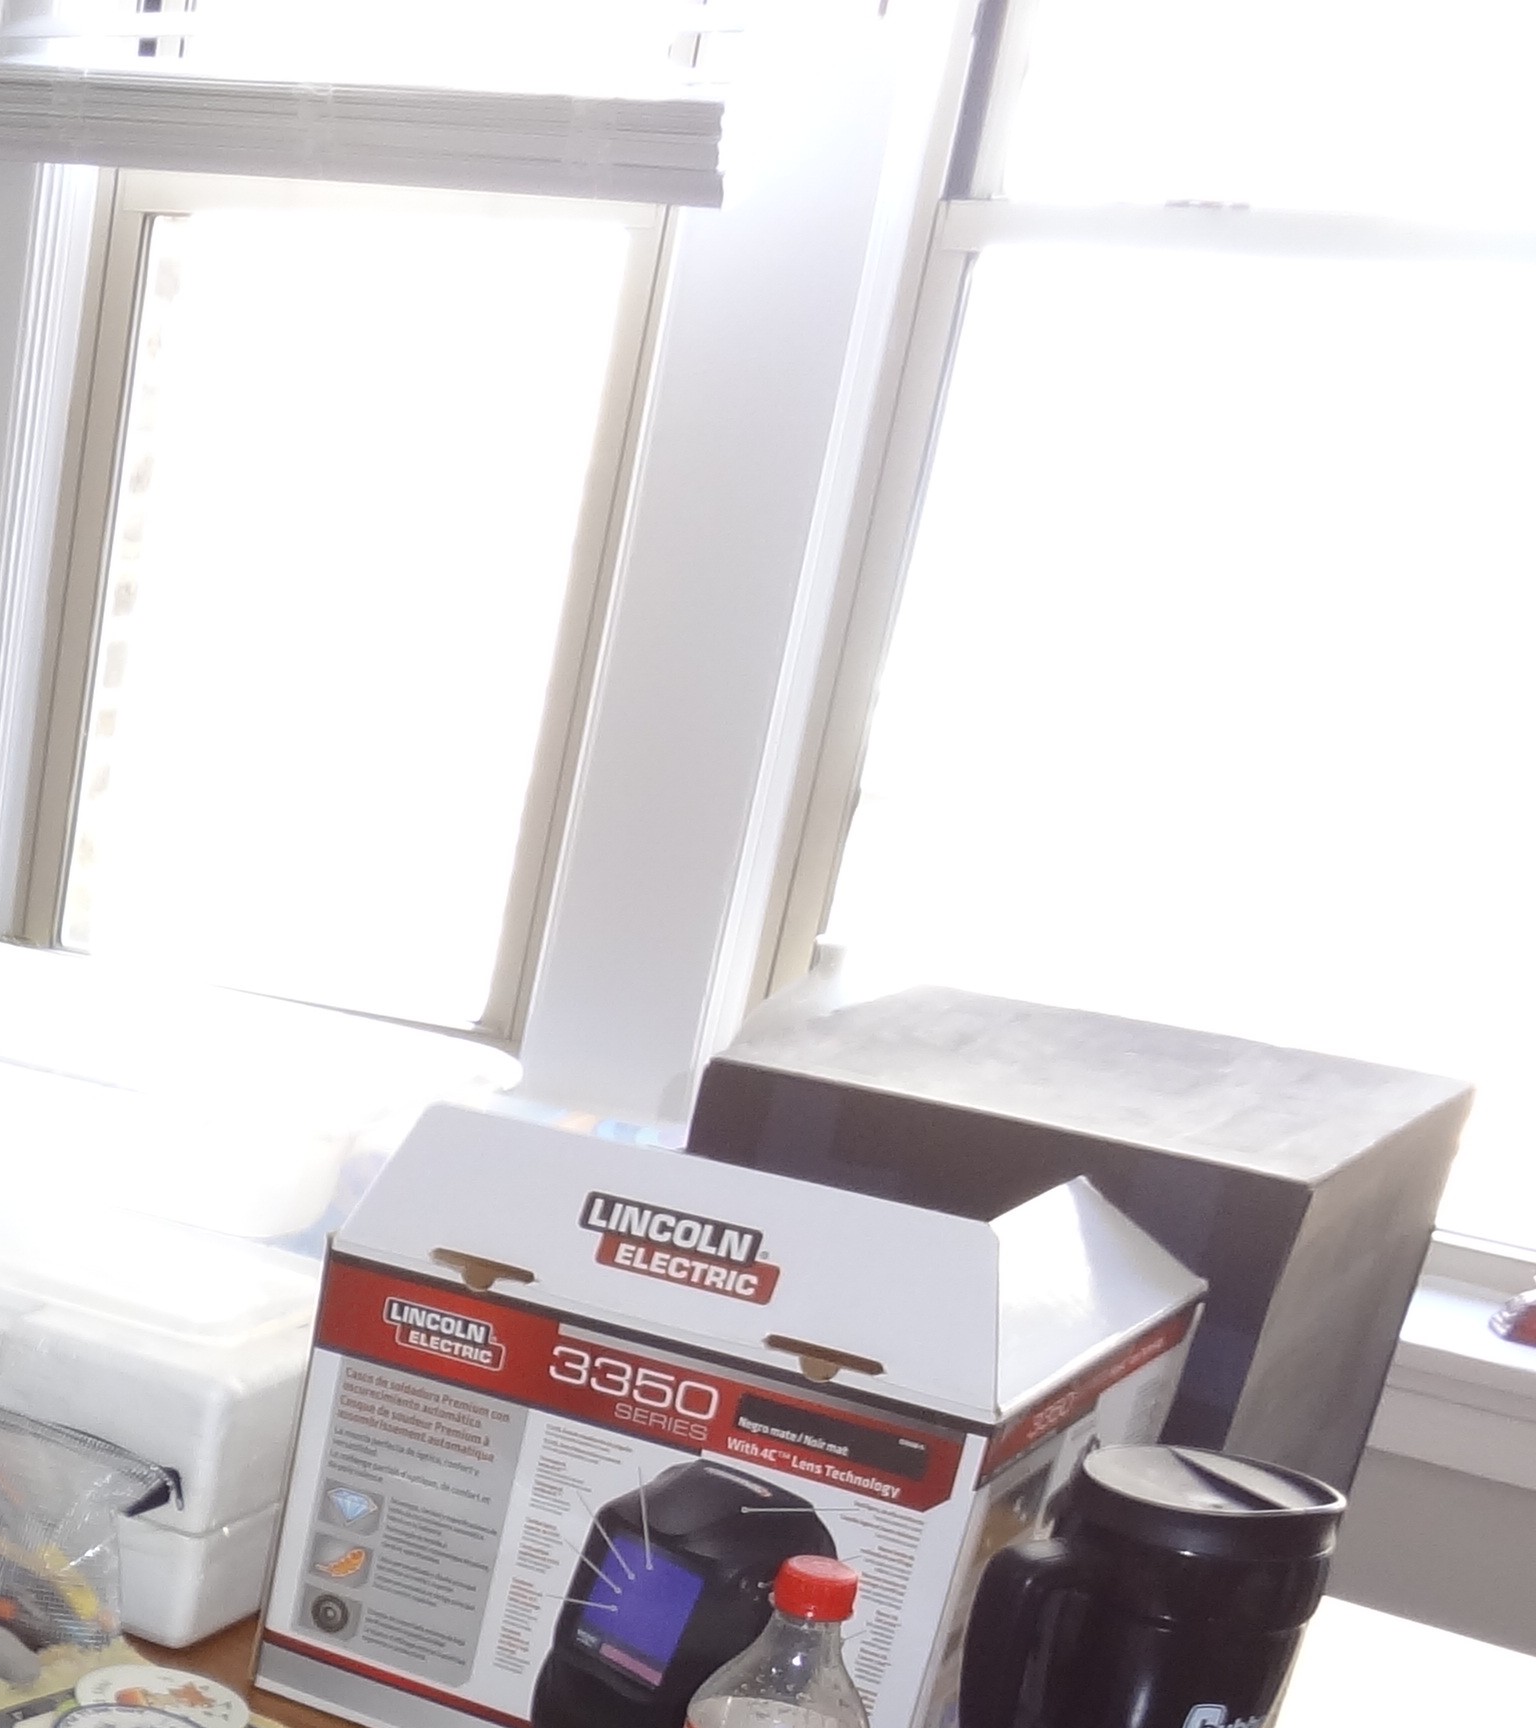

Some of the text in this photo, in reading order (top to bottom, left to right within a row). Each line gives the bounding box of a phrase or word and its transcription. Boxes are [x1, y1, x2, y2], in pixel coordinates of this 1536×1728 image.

[588, 1198, 752, 1262] LINCOLN
[614, 1242, 759, 1296] ELECTRIC
[390, 1302, 487, 1344] LINCOLN
[408, 1331, 494, 1364] ELECTRIC
[549, 1345, 719, 1421] 3350
[441, 1390, 488, 1418] Premium
[490, 1408, 511, 1423] con
[614, 1402, 709, 1442] SERIES
[434, 1418, 483, 1444] Premium
[738, 1416, 769, 1436] Negro
[770, 1425, 797, 1443] mate
[804, 1435, 826, 1451] Noir
[827, 1442, 850, 1457] mat
[727, 1437, 759, 1456] With
[791, 1456, 822, 1475] Lens
[825, 1464, 901, 1499] Technology
